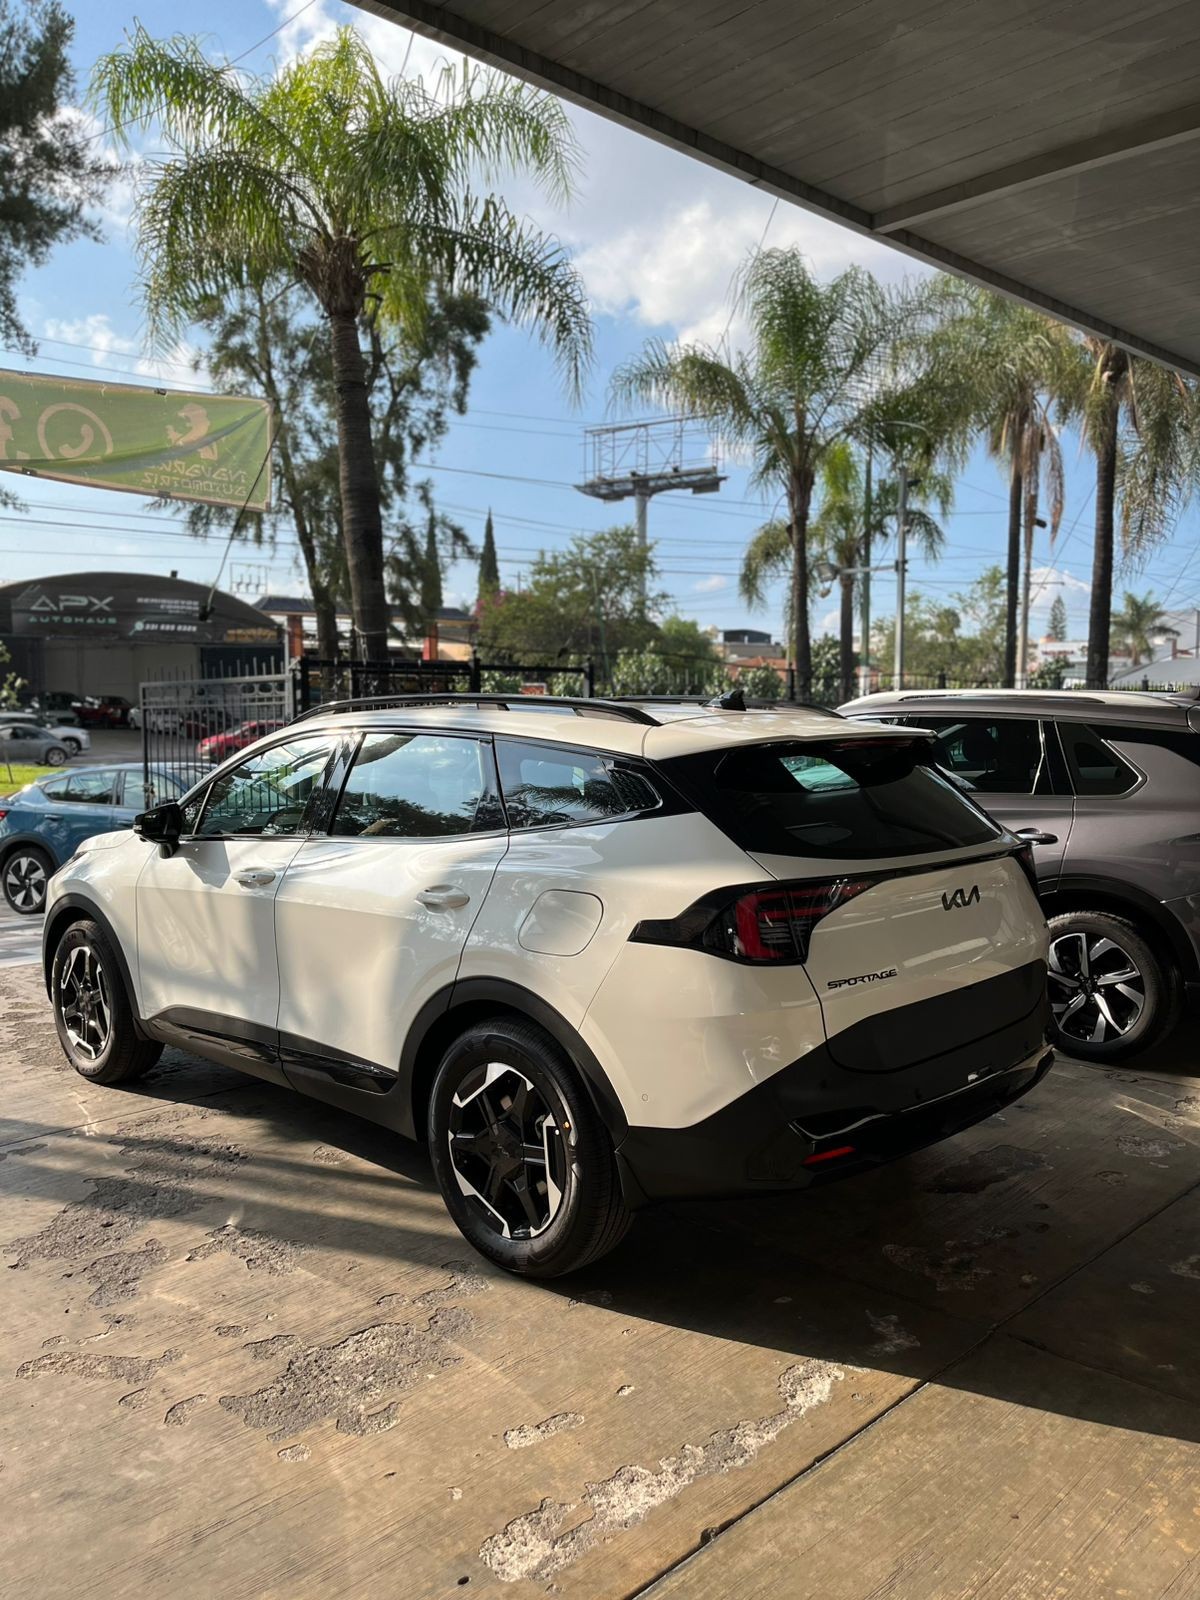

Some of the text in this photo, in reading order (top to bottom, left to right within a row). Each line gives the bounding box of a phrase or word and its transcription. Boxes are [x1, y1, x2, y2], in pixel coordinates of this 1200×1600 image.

[29, 595, 115, 612] APX
[28, 616, 117, 625] AUTOHAUS
[941, 885, 981, 911] KIA
[827, 968, 898, 990] SPORTAGE
